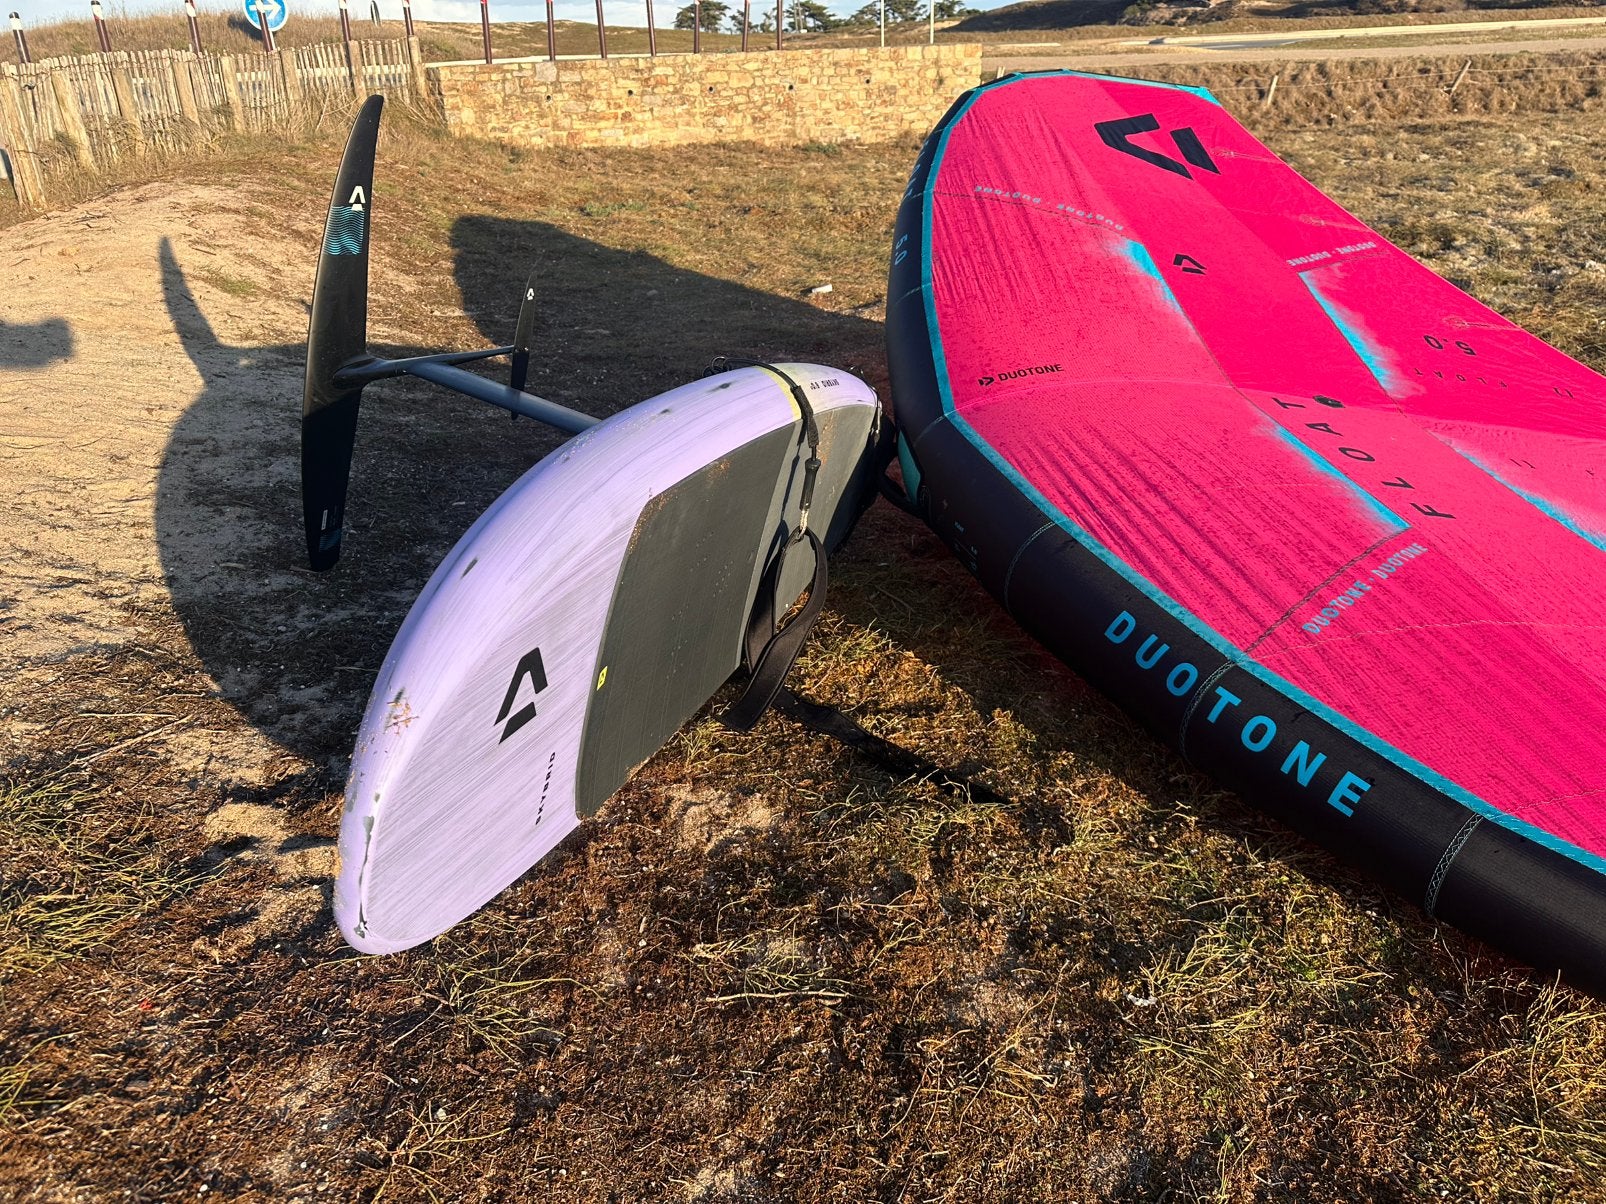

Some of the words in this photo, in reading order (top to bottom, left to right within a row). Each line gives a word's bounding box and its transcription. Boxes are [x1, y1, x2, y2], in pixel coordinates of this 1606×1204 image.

[975, 186, 1041, 204] DUOTONE
[1058, 203, 1123, 231] DUOTONE
[1287, 252, 1331, 265] DUOTONE
[1423, 334, 1477, 356] 5.0
[998, 363, 1063, 381] DUOTONE
[1272, 395, 1457, 521] FLOAT
[1302, 579, 1372, 635] DUOTONE
[1371, 541, 1429, 580] DUOTONE
[1103, 609, 1373, 818] DUOTONE
[535, 752, 556, 826] SKYBRID
